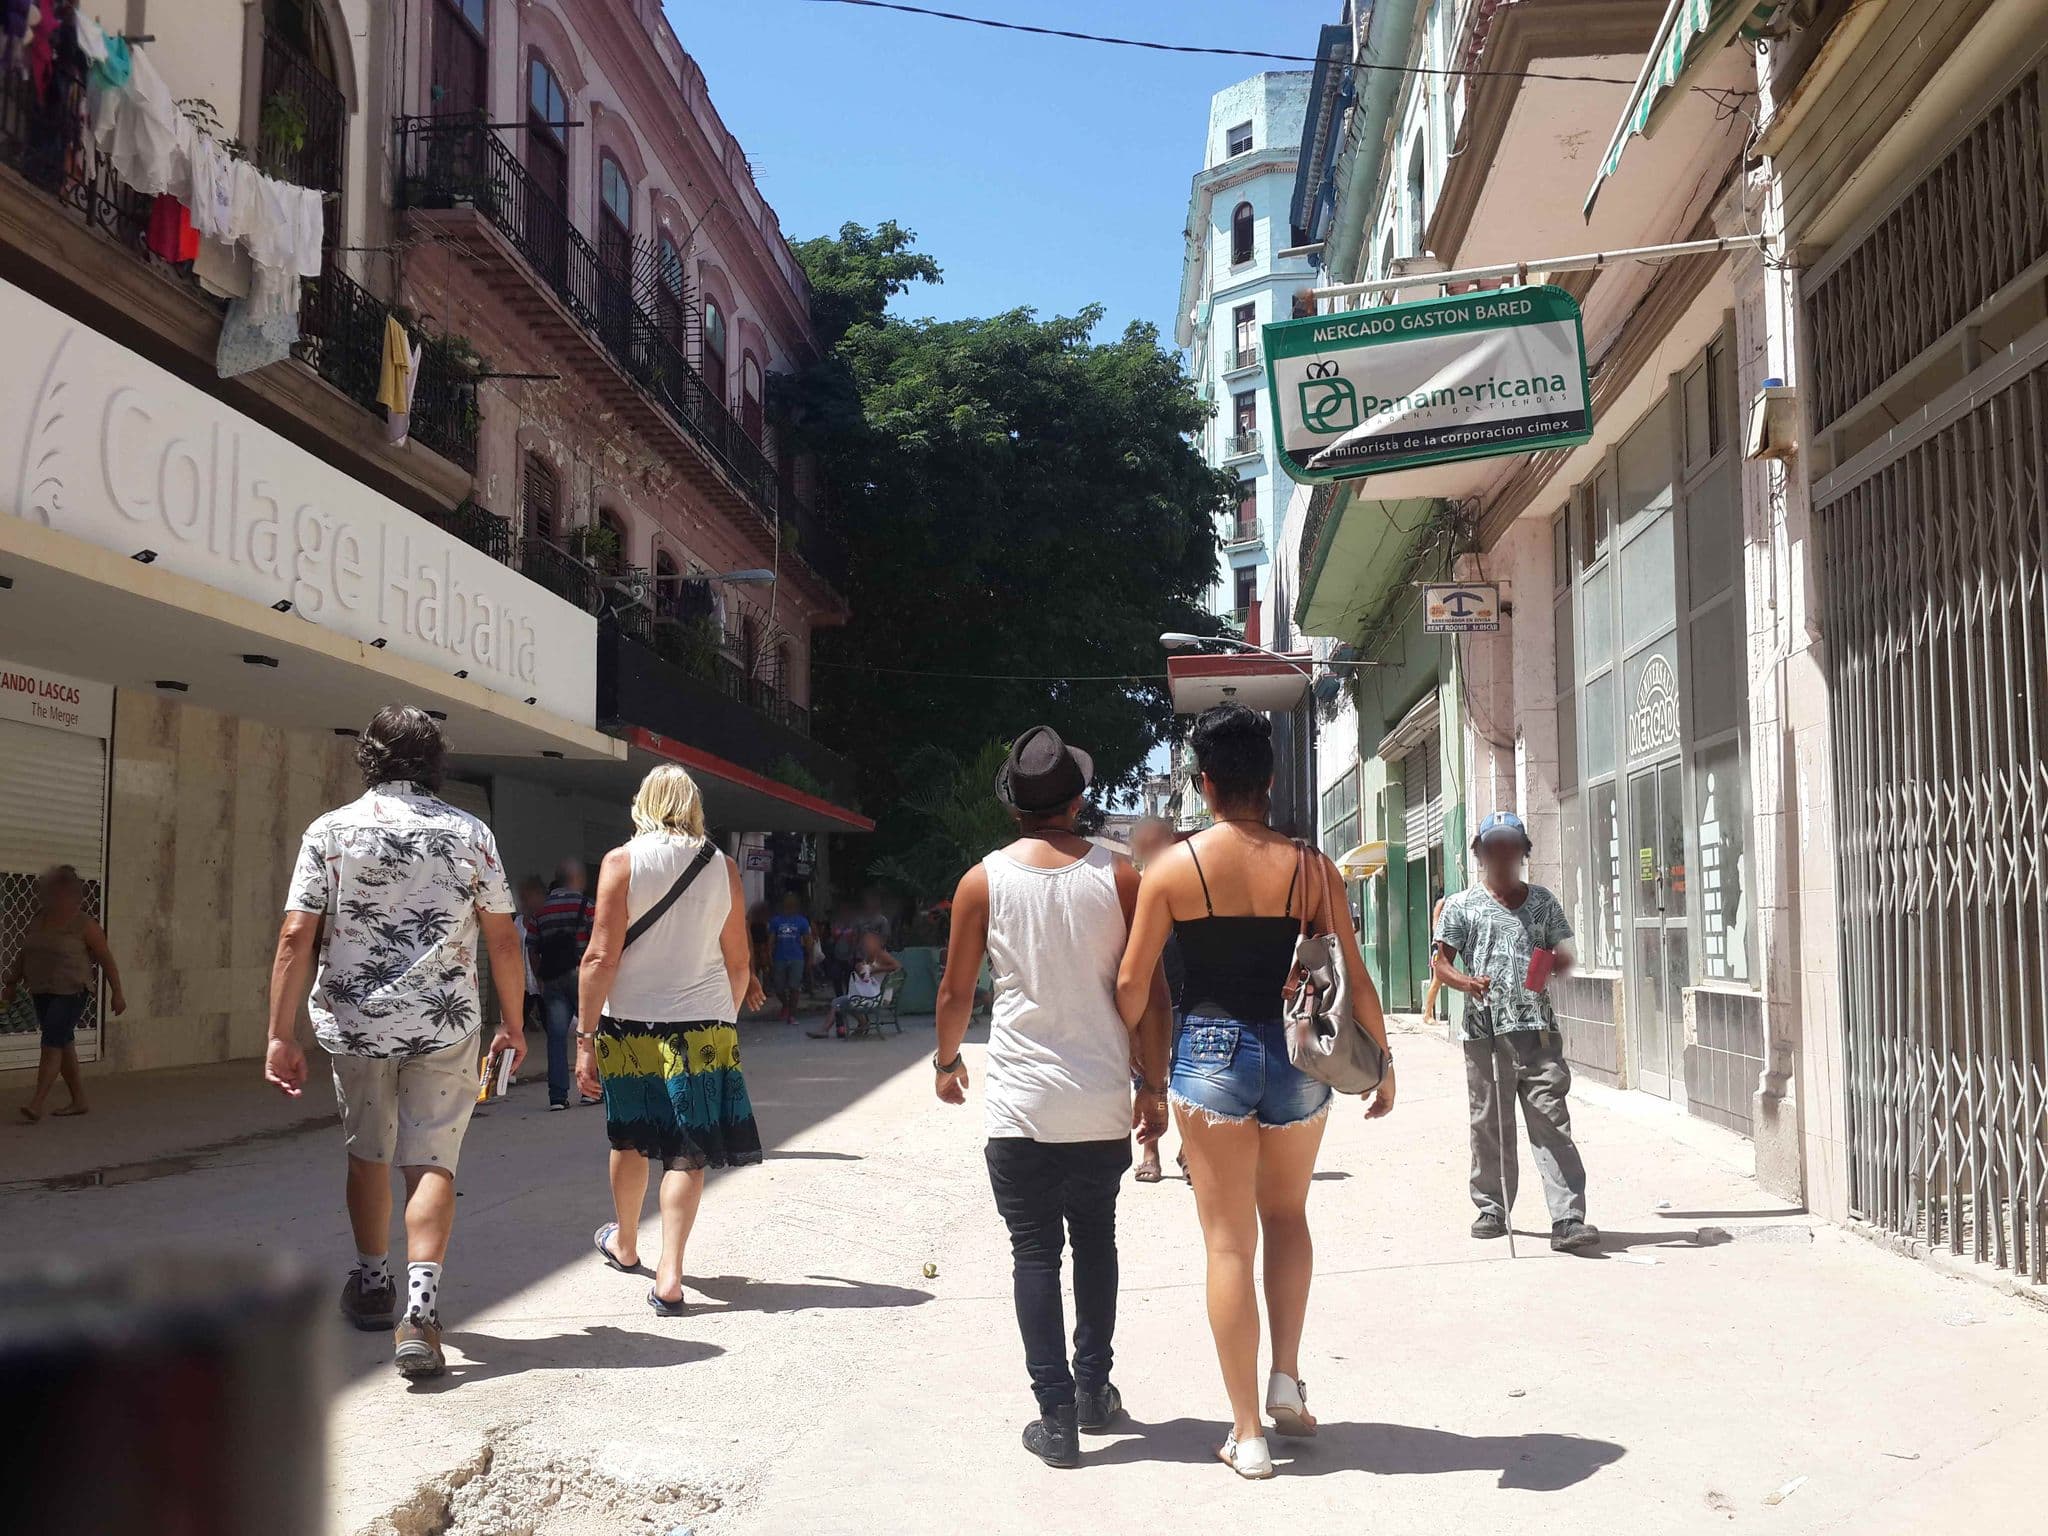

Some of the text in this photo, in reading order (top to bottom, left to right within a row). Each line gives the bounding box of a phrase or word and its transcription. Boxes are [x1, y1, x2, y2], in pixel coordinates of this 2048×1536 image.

[1313, 299, 1532, 342] MERCADO GASTON BARED
[1363, 374, 1566, 418] Panamericana
[1365, 394, 1566, 426] CADENA DE TIENDAS
[1336, 442, 1399, 457] minorista
[1404, 436, 1420, 448] de
[1425, 434, 1437, 446] la
[1441, 424, 1523, 444] corporacion
[1528, 419, 1569, 433] cimex
[102, 386, 537, 684] Collage Habana
[0, 671, 80, 704] ANDO LASCAS
[32, 702, 79, 727] The Merger
